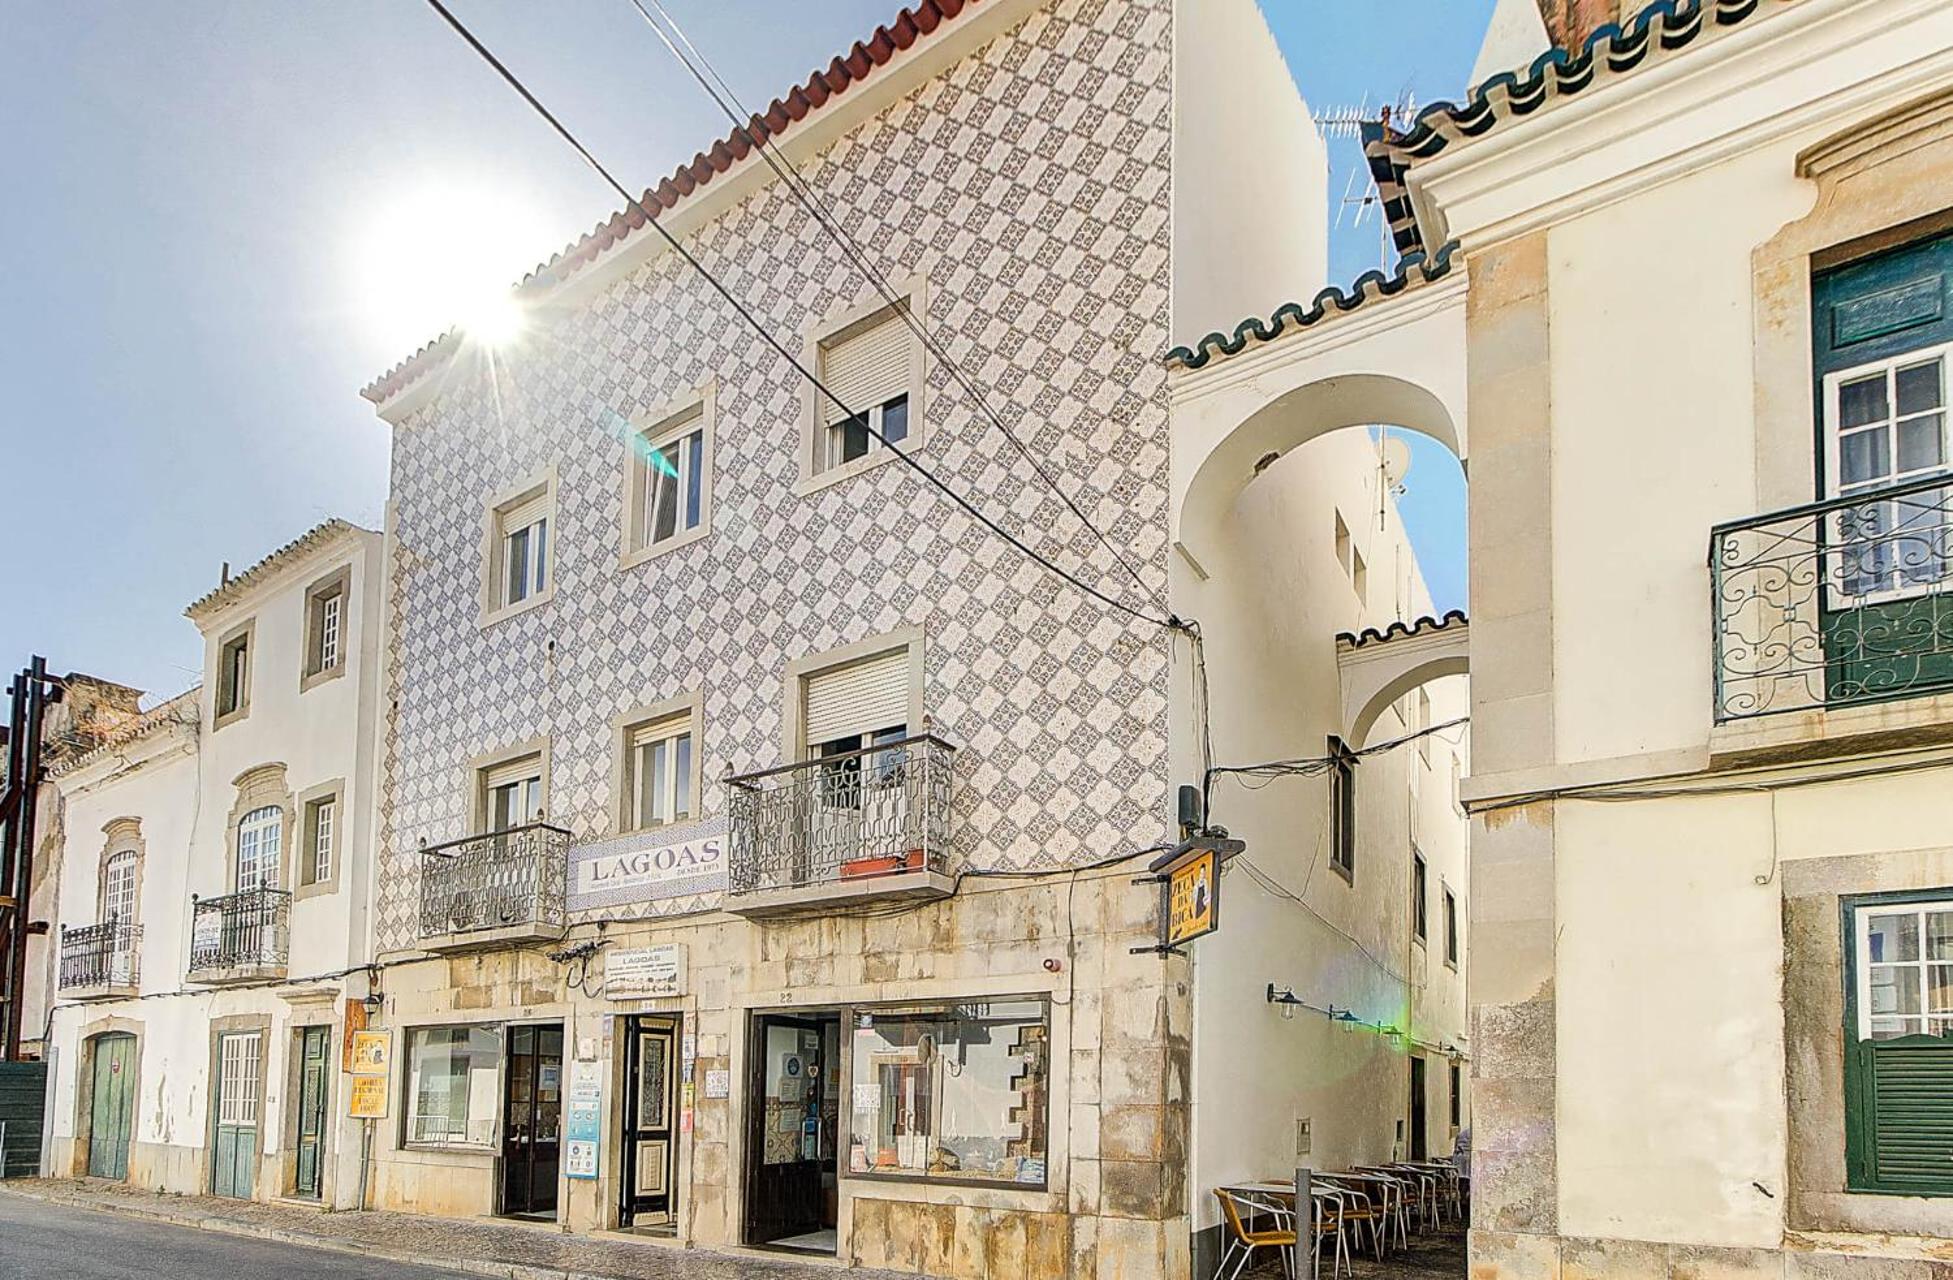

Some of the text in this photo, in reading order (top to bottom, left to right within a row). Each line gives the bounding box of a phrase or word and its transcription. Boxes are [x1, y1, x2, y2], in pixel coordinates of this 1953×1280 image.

[592, 840, 720, 881] LAGOAS
[1172, 874, 1194, 897] ZECA
[1172, 906, 1193, 928] BICA
[622, 955, 661, 964] LAGOAS
[779, 992, 793, 1003] 22
